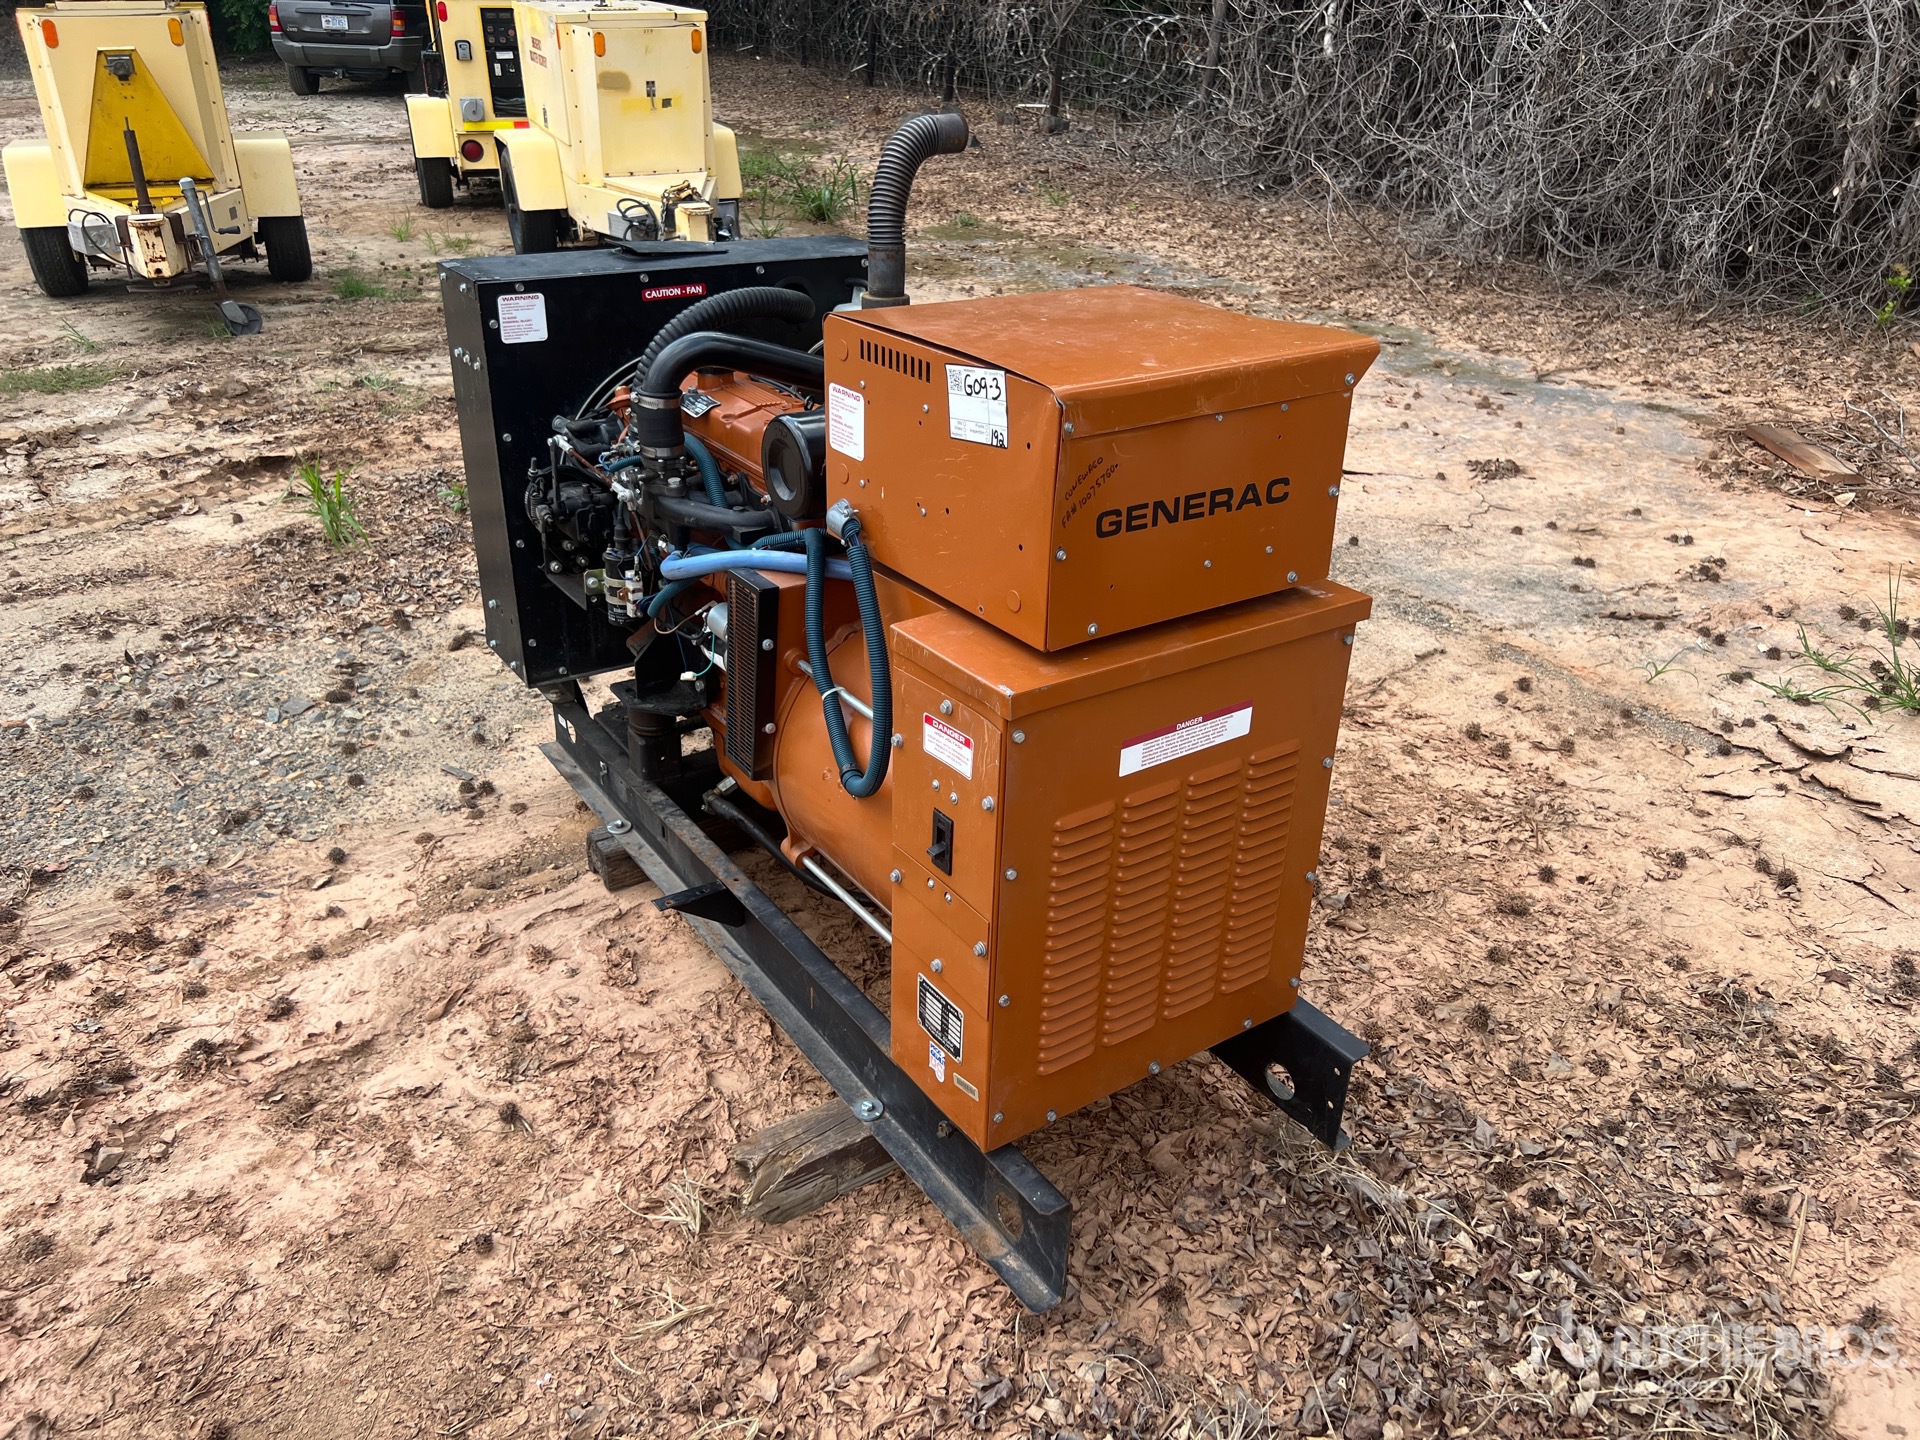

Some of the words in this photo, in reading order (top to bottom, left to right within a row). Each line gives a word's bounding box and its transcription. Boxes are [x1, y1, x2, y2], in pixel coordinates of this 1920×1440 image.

[645, 288, 681, 299] CAUTION
[687, 286, 702, 294] FAN
[833, 387, 860, 402] WARNING
[964, 374, 1001, 400] G09-3
[991, 429, 1005, 448] 192
[1096, 477, 1290, 538] GENERAC
[933, 720, 965, 745] DANGER
[1176, 717, 1203, 730] DANGER
